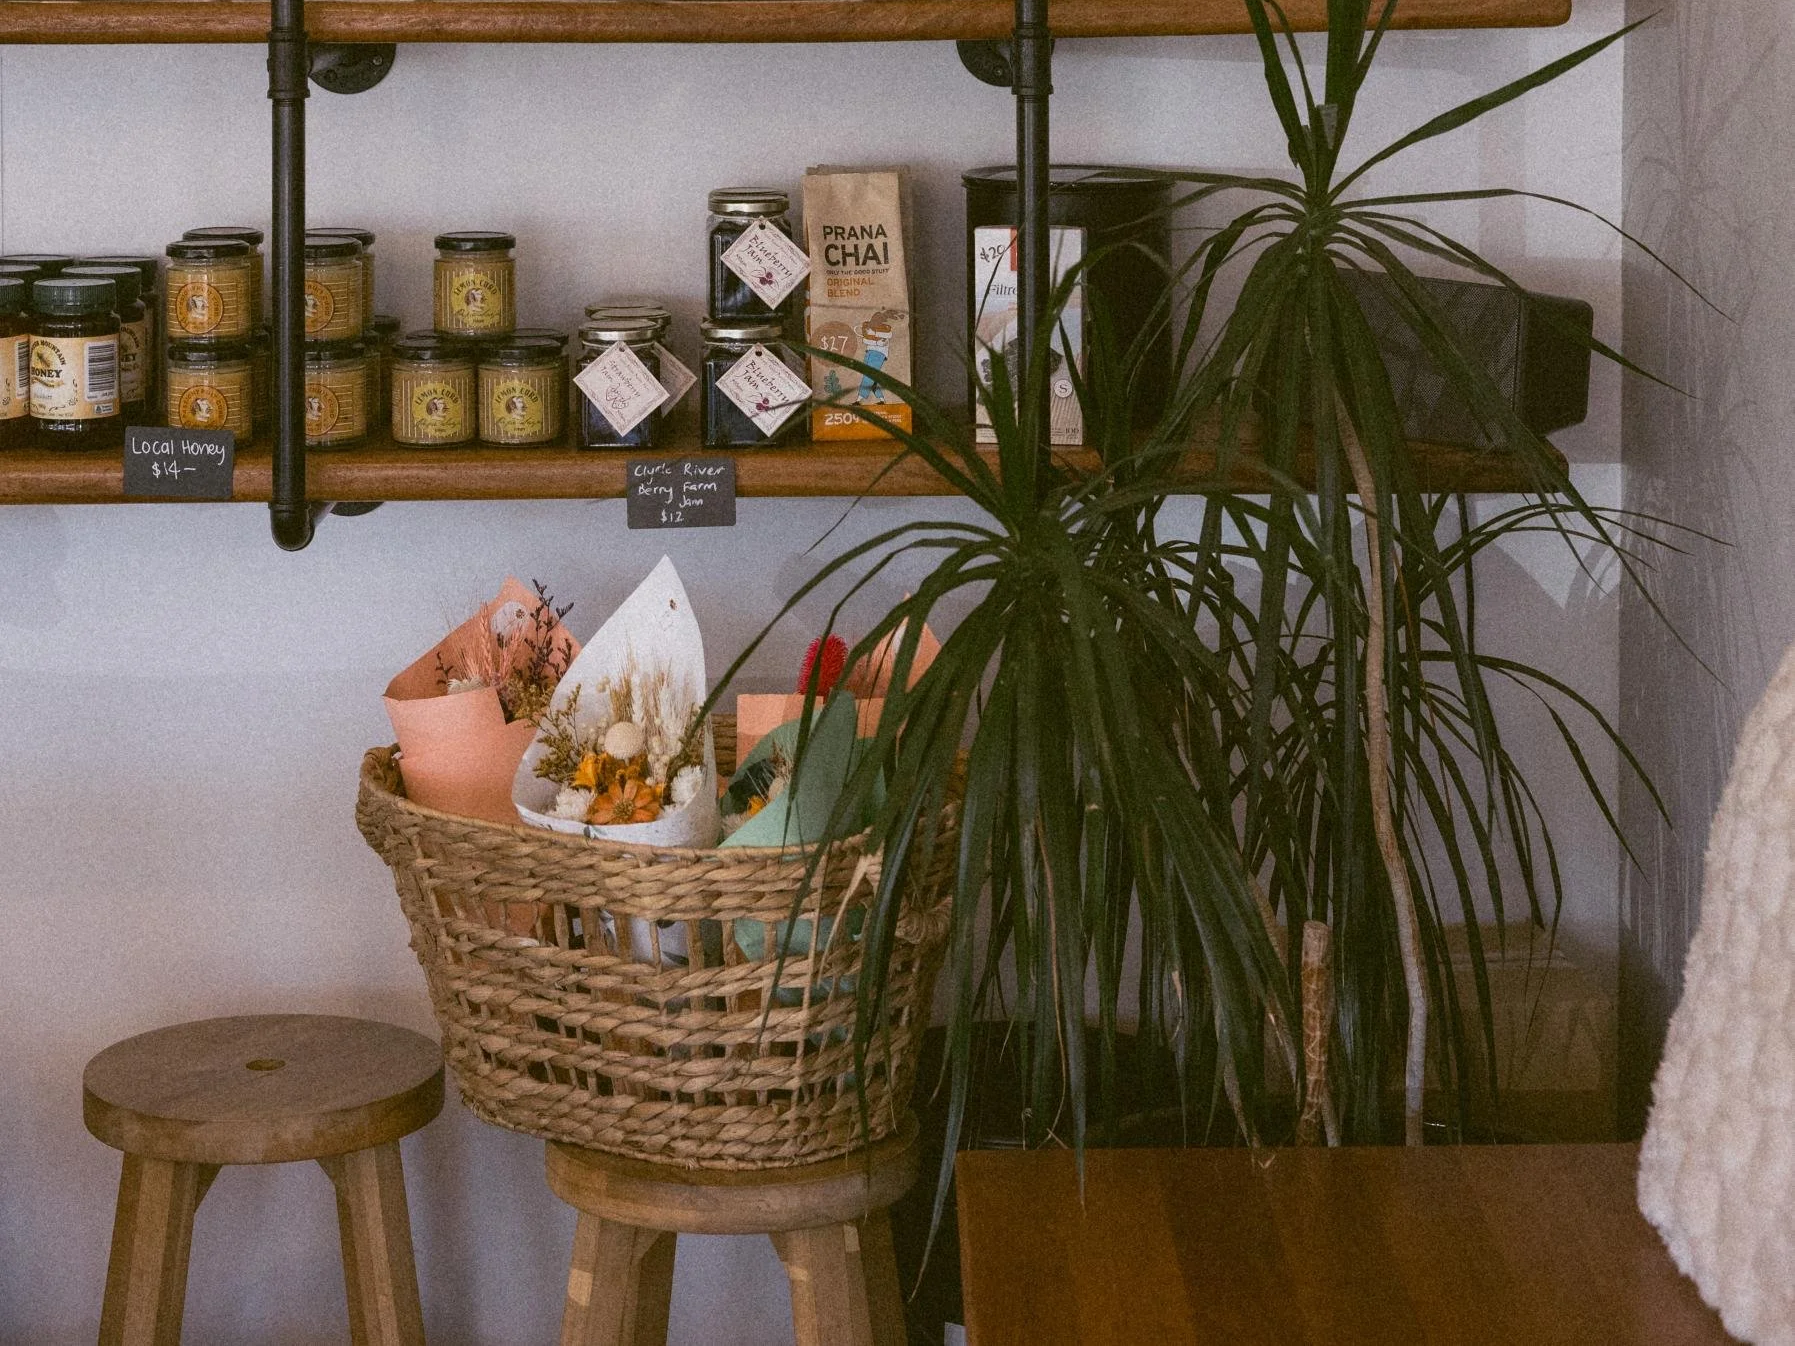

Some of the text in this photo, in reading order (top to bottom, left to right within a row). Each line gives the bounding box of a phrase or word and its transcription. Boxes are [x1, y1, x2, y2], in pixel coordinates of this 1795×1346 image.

[822, 223, 888, 241] PRANA
[740, 244, 763, 265] Jam
[748, 234, 793, 281] Blueberry
[824, 241, 890, 267] CHAI
[826, 277, 875, 287] ORIGINAL
[827, 288, 861, 298] BLEND
[40, 340, 67, 366] MOUNTAIN
[820, 335, 849, 354] $27
[734, 369, 760, 390] Jam
[132, 437, 226, 466] Local Honey
[683, 462, 727, 476] River
[638, 480, 718, 504] Berry Farm
[679, 494, 704, 508] Jam
[660, 509, 685, 523] $12
